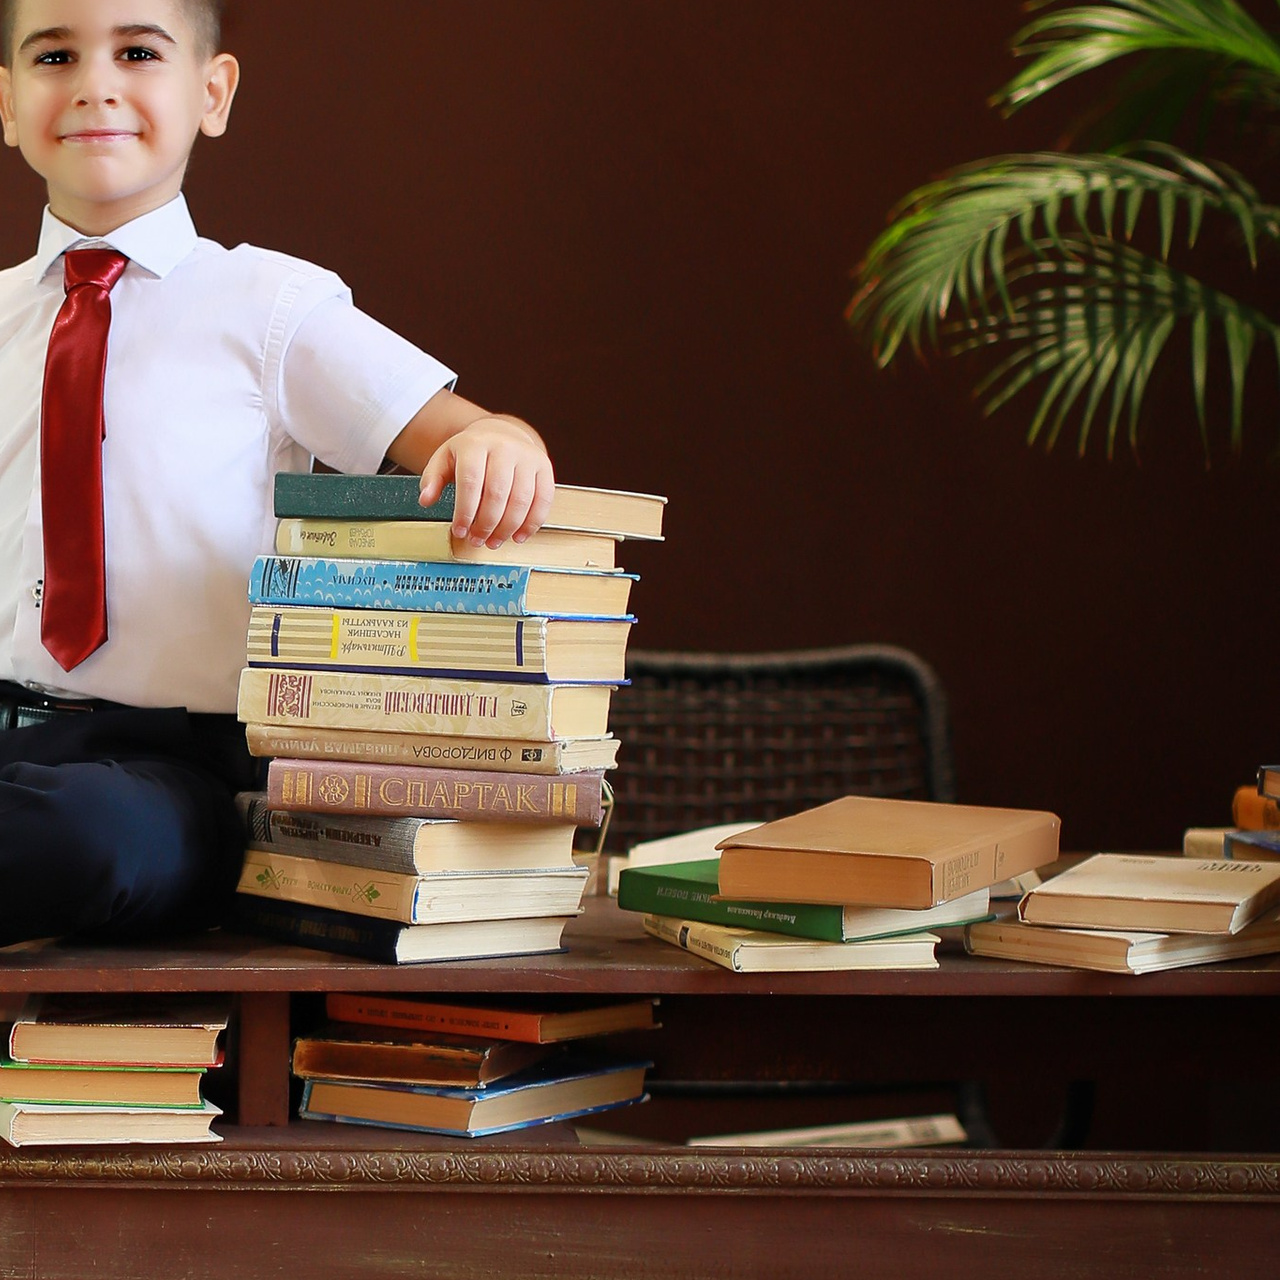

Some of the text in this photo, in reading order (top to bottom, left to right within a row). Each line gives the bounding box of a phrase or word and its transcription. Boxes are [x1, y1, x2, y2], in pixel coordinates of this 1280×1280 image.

[332, 574, 376, 587] ЦУСИМА
[342, 616, 408, 628] ИЗ КАЛЬКУТТЫ
[347, 628, 402, 639] НАСЛЕДНИК
[378, 776, 540, 814] СПАРТАК
